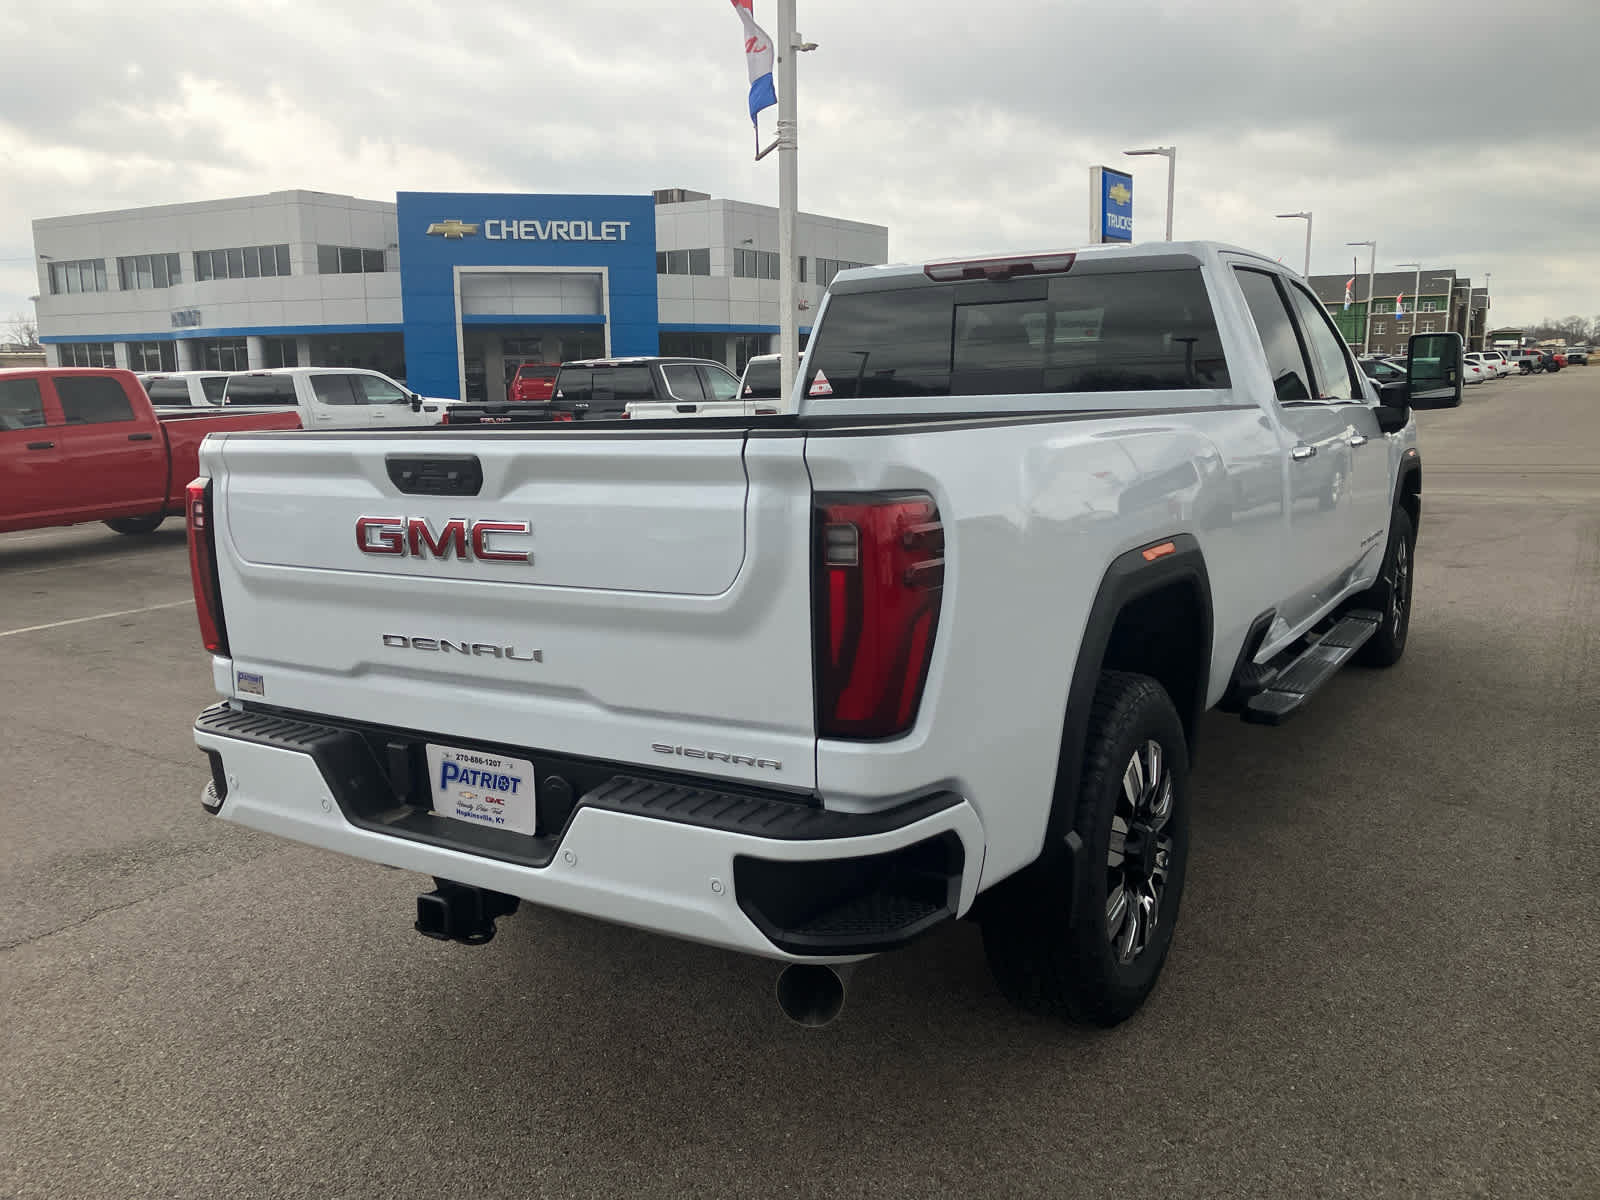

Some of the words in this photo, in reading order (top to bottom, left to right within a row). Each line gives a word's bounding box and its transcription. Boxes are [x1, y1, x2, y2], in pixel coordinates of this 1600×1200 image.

[484, 219, 631, 241] CHEVROLET
[1106, 212, 1133, 231] TRUCKS
[355, 515, 534, 566] GMC
[382, 633, 543, 663] DENALI
[455, 753, 502, 768] 270-886-1207
[651, 743, 782, 770] SIERRA
[440, 761, 521, 793] PATRIOT
